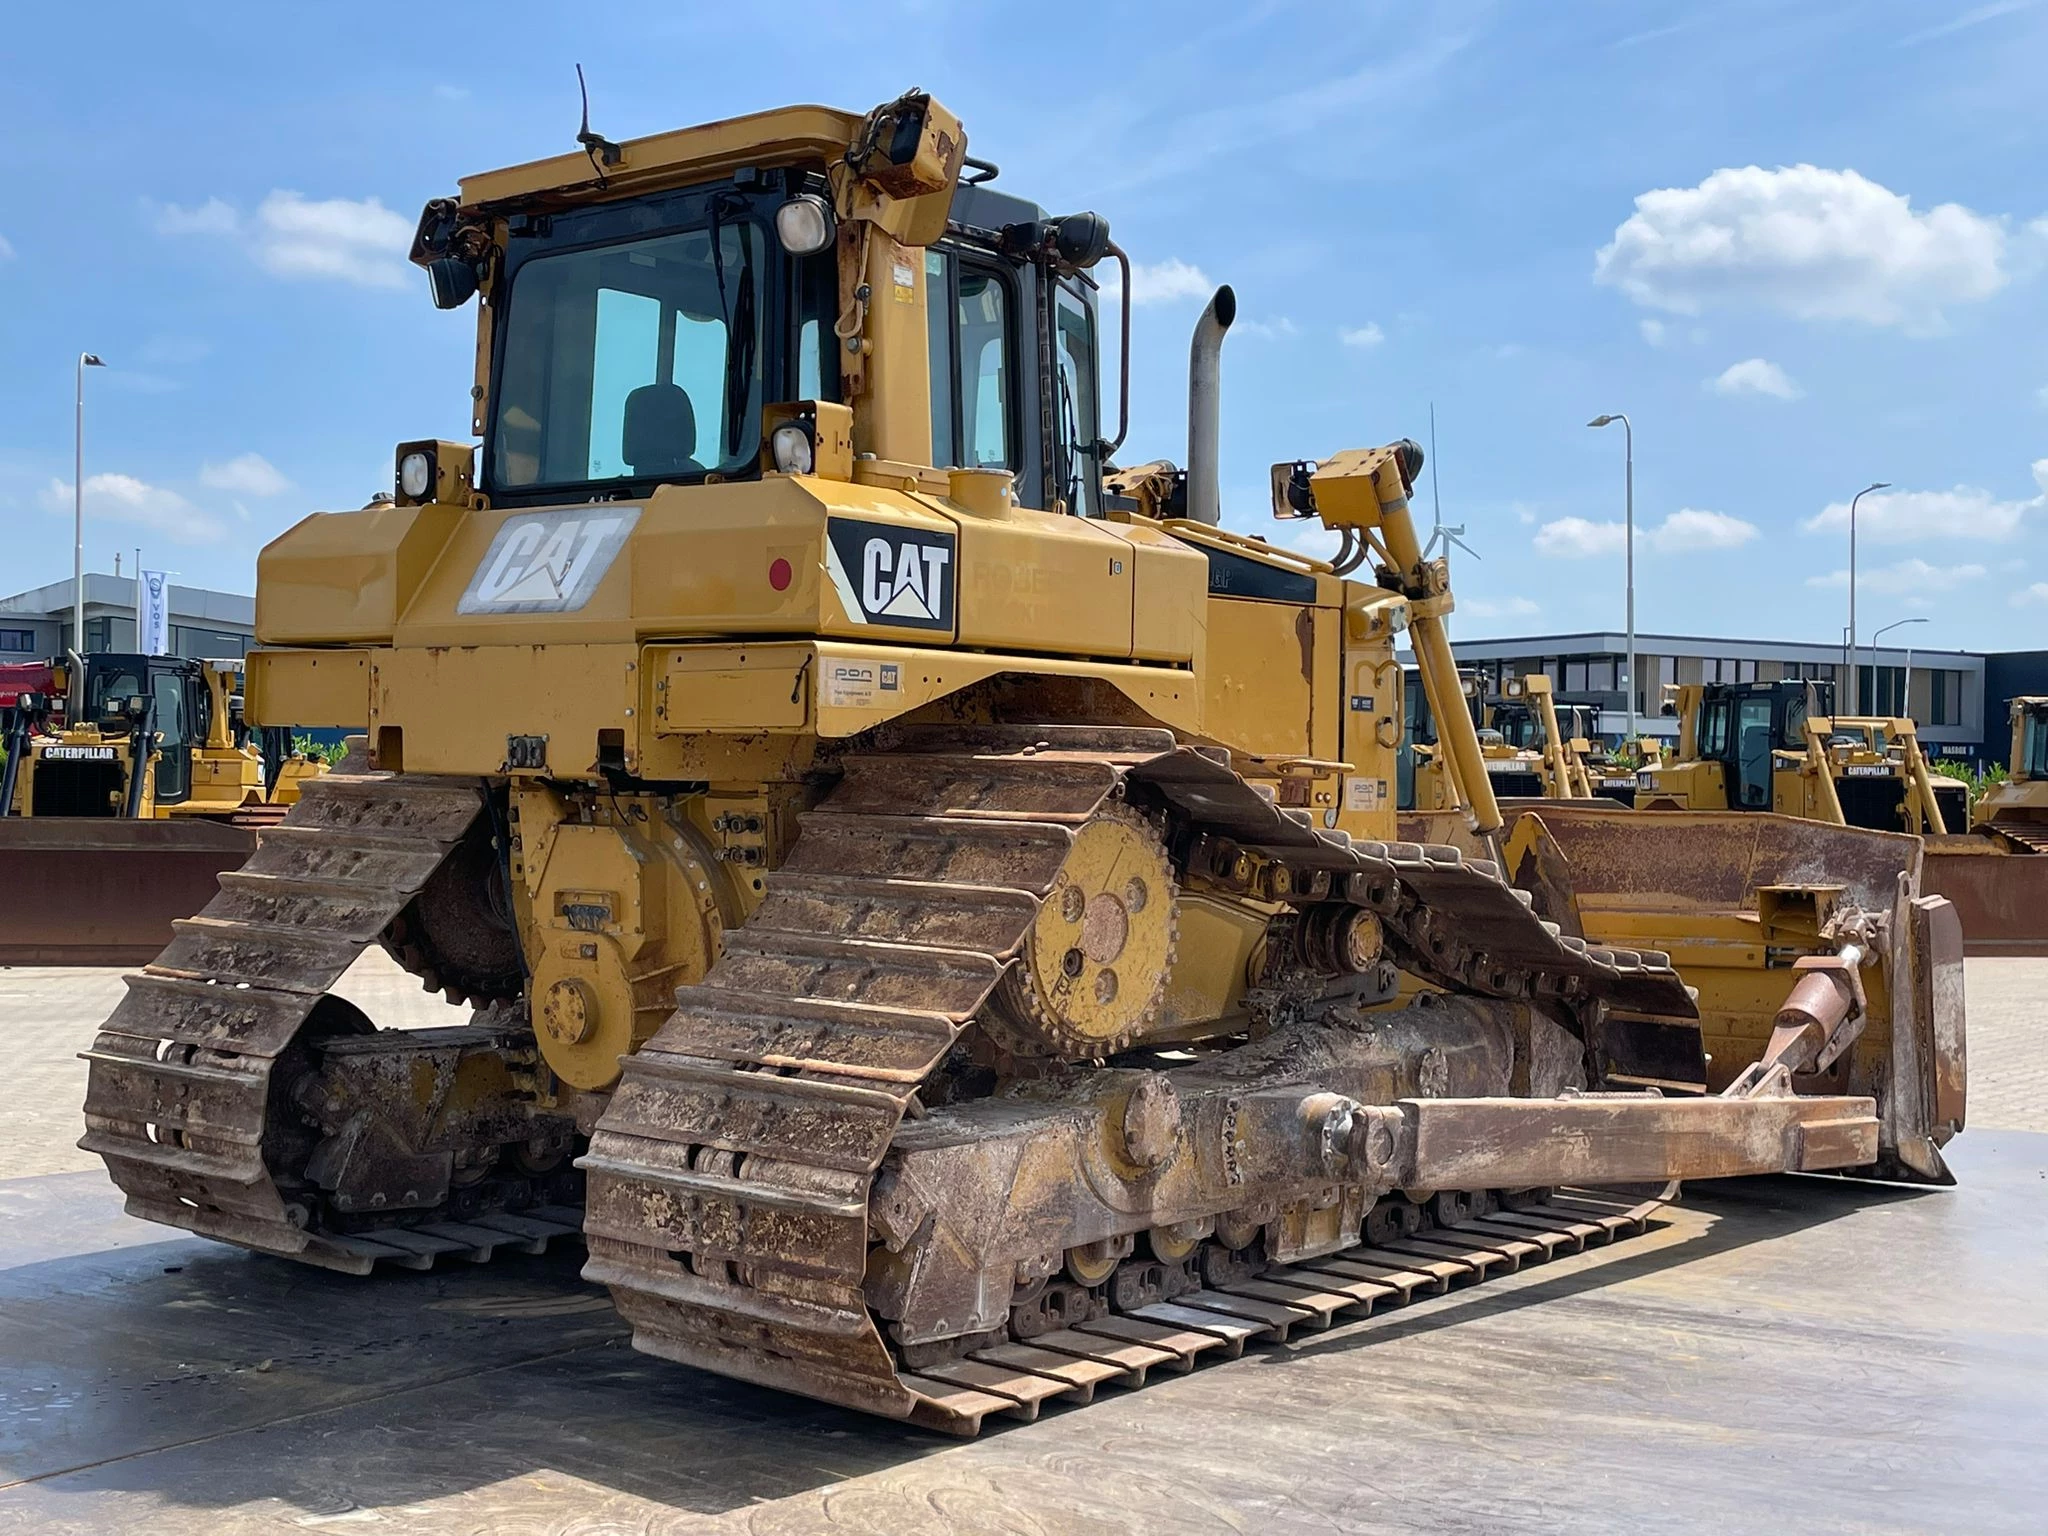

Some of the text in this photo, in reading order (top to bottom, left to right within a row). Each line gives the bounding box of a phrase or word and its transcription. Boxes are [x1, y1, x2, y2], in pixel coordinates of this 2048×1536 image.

[477, 517, 624, 602] CAT
[862, 537, 949, 620] CAT
[152, 603, 161, 629] VOS
[835, 668, 872, 681] pon
[881, 671, 897, 684] CAT
[45, 747, 114, 760] CATERPILLAR
[1848, 766, 1890, 776] CATERPILLAR
[1640, 773, 1651, 790] CAT
